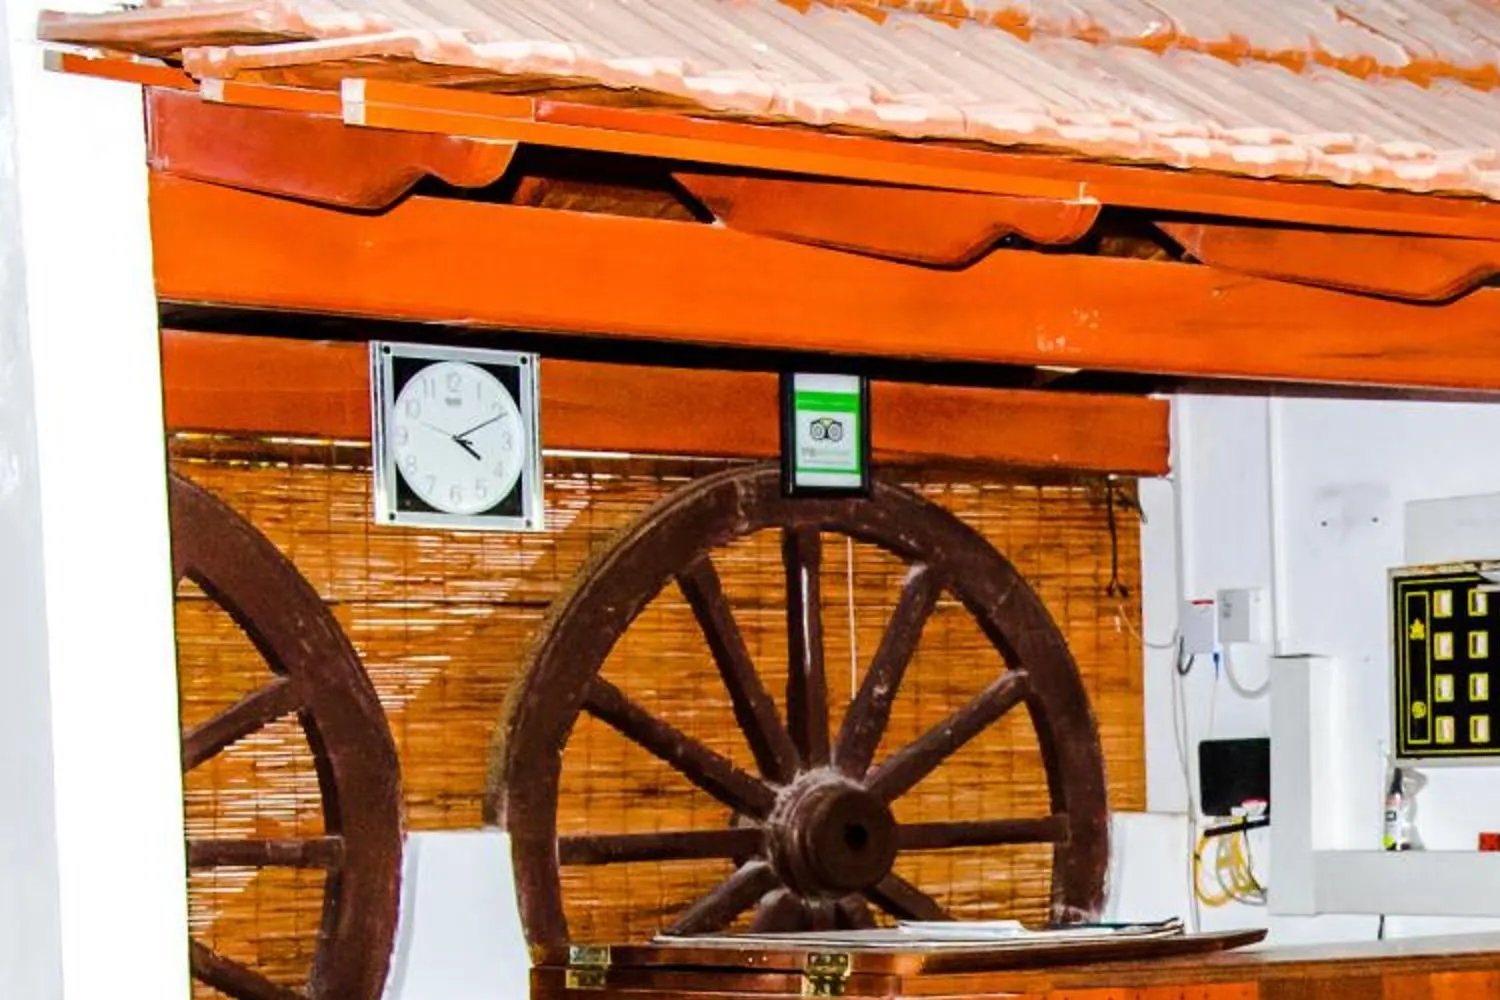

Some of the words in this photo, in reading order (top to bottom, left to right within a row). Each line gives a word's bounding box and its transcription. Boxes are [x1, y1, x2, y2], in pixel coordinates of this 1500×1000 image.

[422, 377, 437, 400] 11
[446, 372, 463, 392] 12
[405, 398, 422, 420] 10
[396, 425, 409, 446] 9
[501, 431, 513, 451] 3
[406, 454, 418, 475] 8
[493, 461, 505, 478] 4
[424, 473, 437, 495] 7
[449, 484, 463, 505] 6
[474, 478, 488, 498] 5
